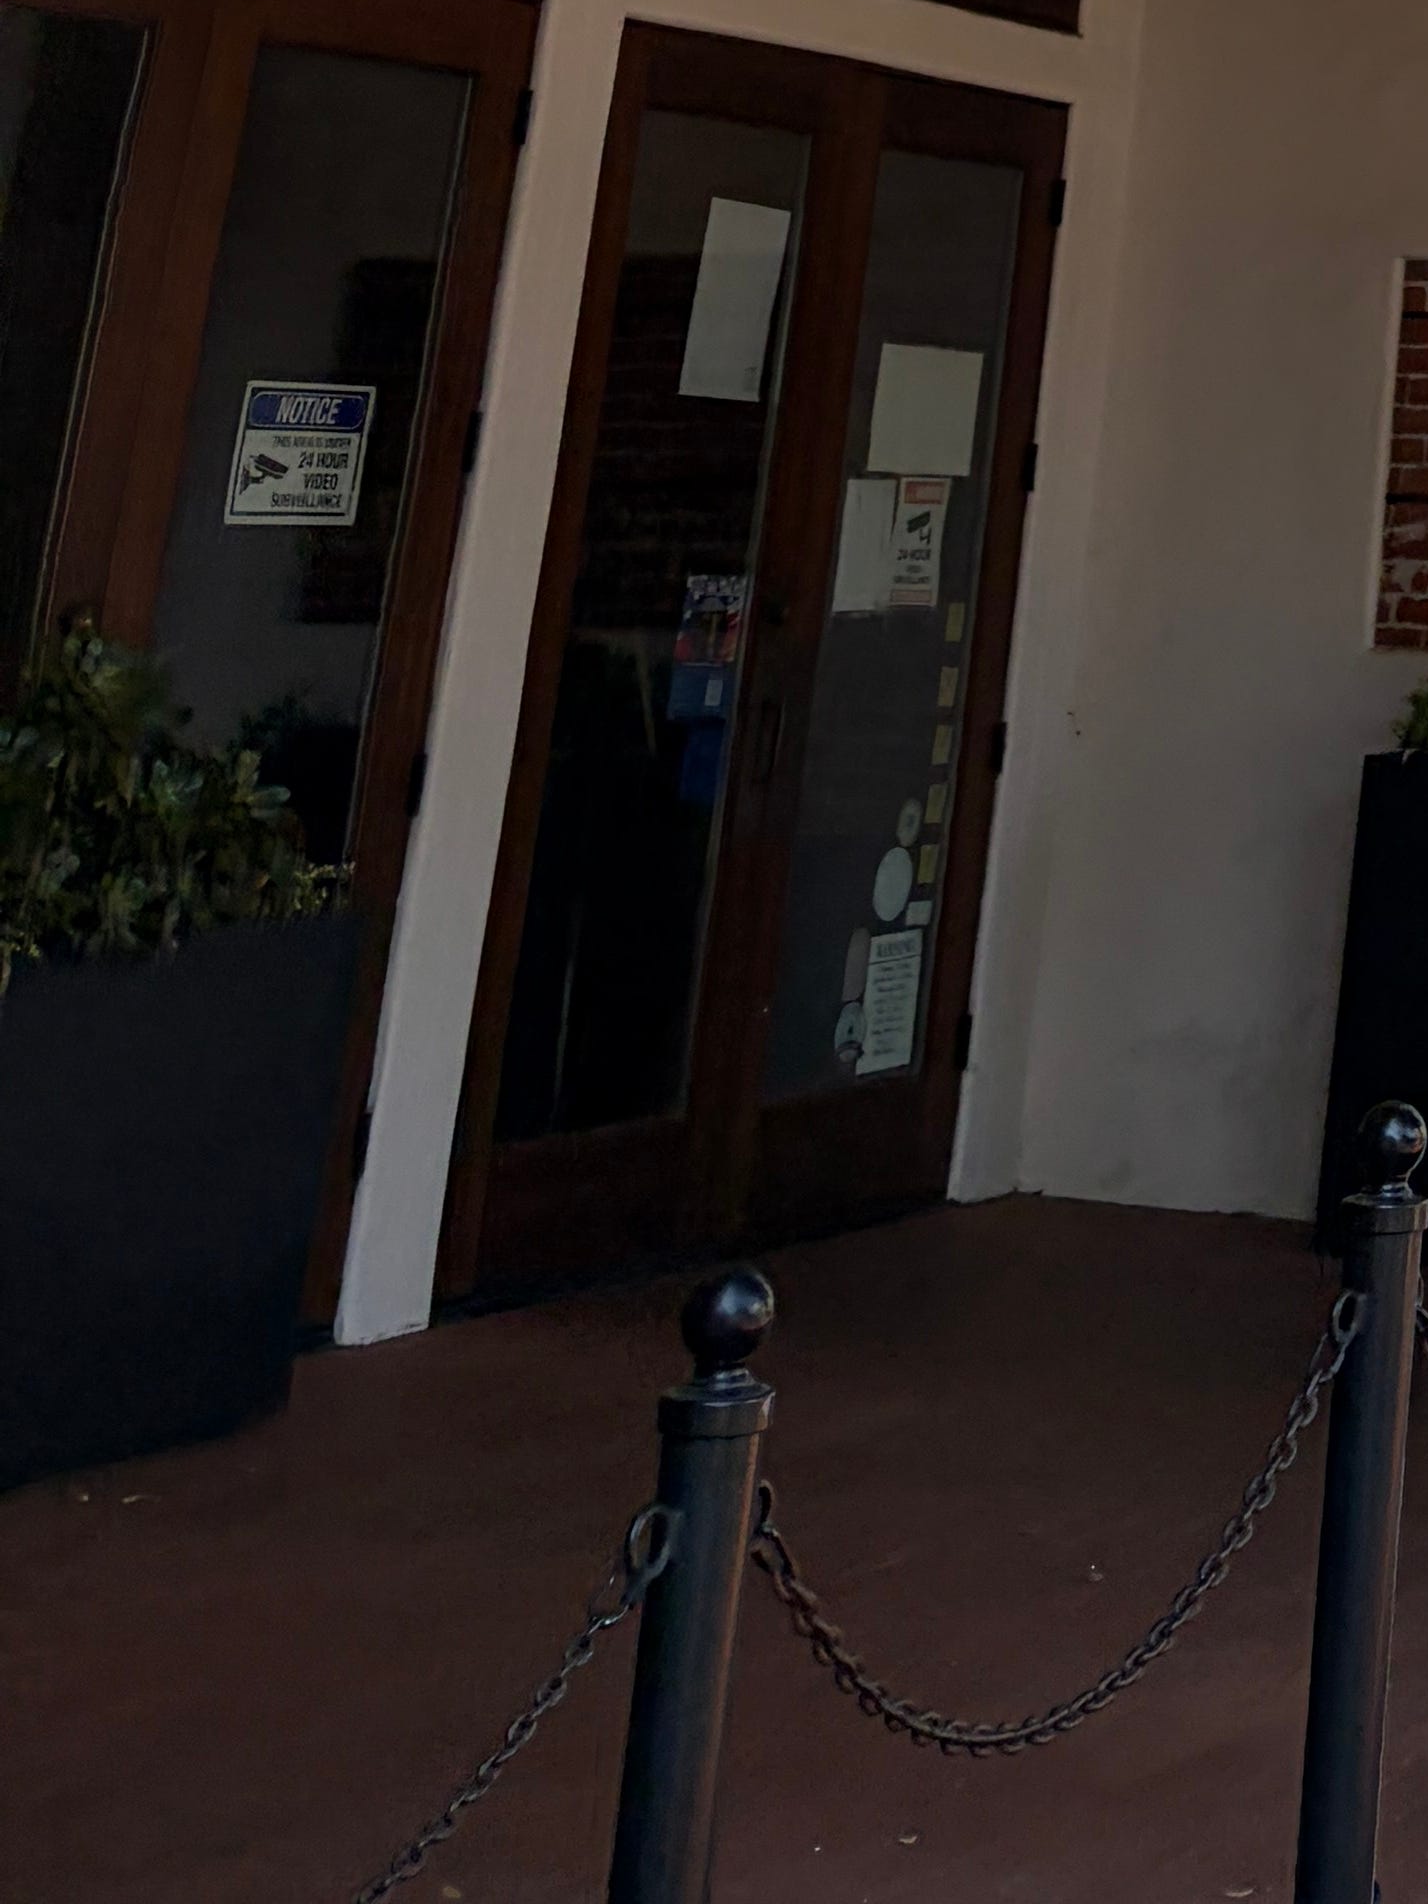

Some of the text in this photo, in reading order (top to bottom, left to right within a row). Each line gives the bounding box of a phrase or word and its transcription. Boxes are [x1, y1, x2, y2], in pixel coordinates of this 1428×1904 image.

[275, 395, 343, 425] NOTICE
[298, 452, 349, 469] 24 HOUR
[303, 473, 338, 490] VIDEO
